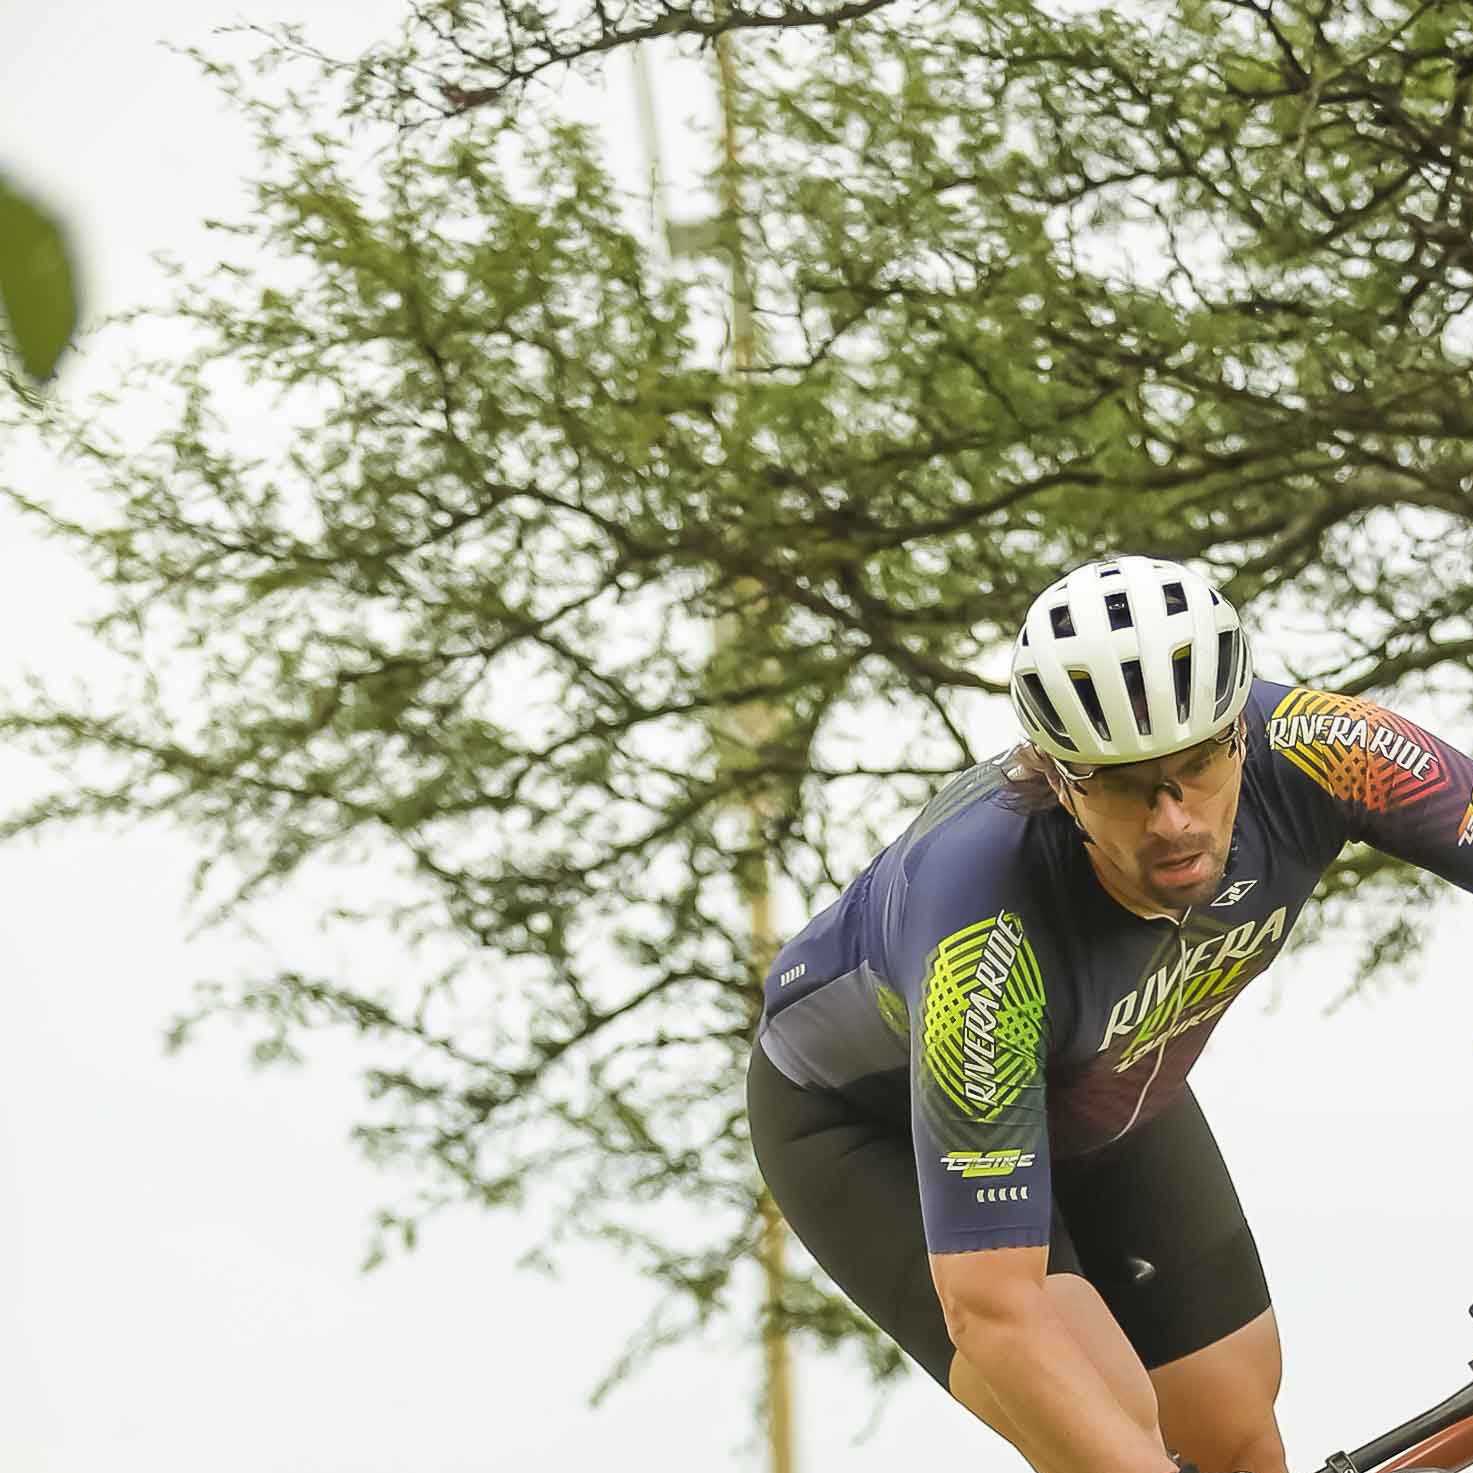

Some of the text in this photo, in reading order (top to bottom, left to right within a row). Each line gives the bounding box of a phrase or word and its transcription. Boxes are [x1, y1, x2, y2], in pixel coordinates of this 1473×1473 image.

[1268, 713, 1440, 782] RIVERA RIDE
[963, 909, 1024, 1106] RIVERA RIDE
[1096, 906, 1287, 1053] RIVERA
